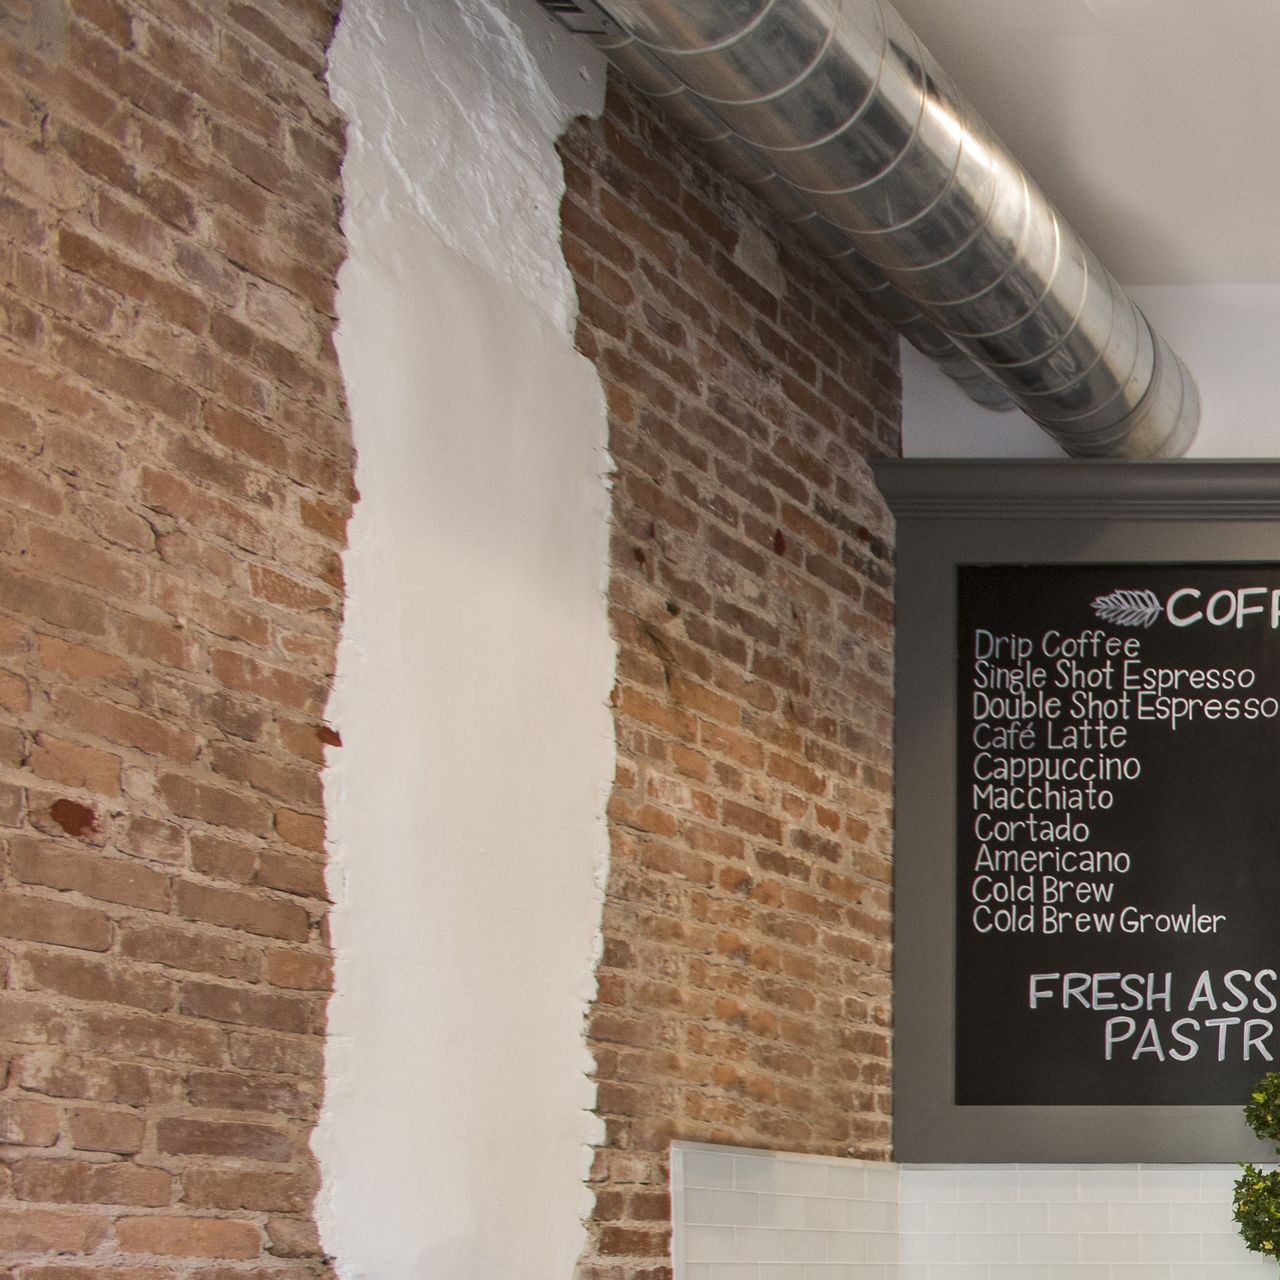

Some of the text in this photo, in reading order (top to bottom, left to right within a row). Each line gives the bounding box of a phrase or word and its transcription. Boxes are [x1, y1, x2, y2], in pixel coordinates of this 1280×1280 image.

[976, 629, 1032, 666] Drip
[1042, 630, 1140, 657] Coffee
[974, 660, 1046, 694] Single
[1054, 659, 1114, 689] Shot
[1124, 660, 1255, 696] Espresso
[974, 690, 1061, 720] Double
[1070, 691, 1130, 720] Shot
[1138, 691, 1278, 730] Espresso
[974, 721, 1035, 749] Café
[1048, 720, 1127, 749] Latte
[974, 752, 1141, 789] Cappuccino
[973, 781, 1113, 810] Macchiato
[975, 813, 1089, 842] Cortado
[975, 843, 1130, 873] Americano
[972, 875, 1034, 903] Cold
[1043, 876, 1114, 903] Brew
[973, 905, 1034, 933] Cold
[1043, 906, 1115, 934] Brew
[1120, 904, 1226, 933] Growler
[1030, 972, 1172, 1012] FRESH
